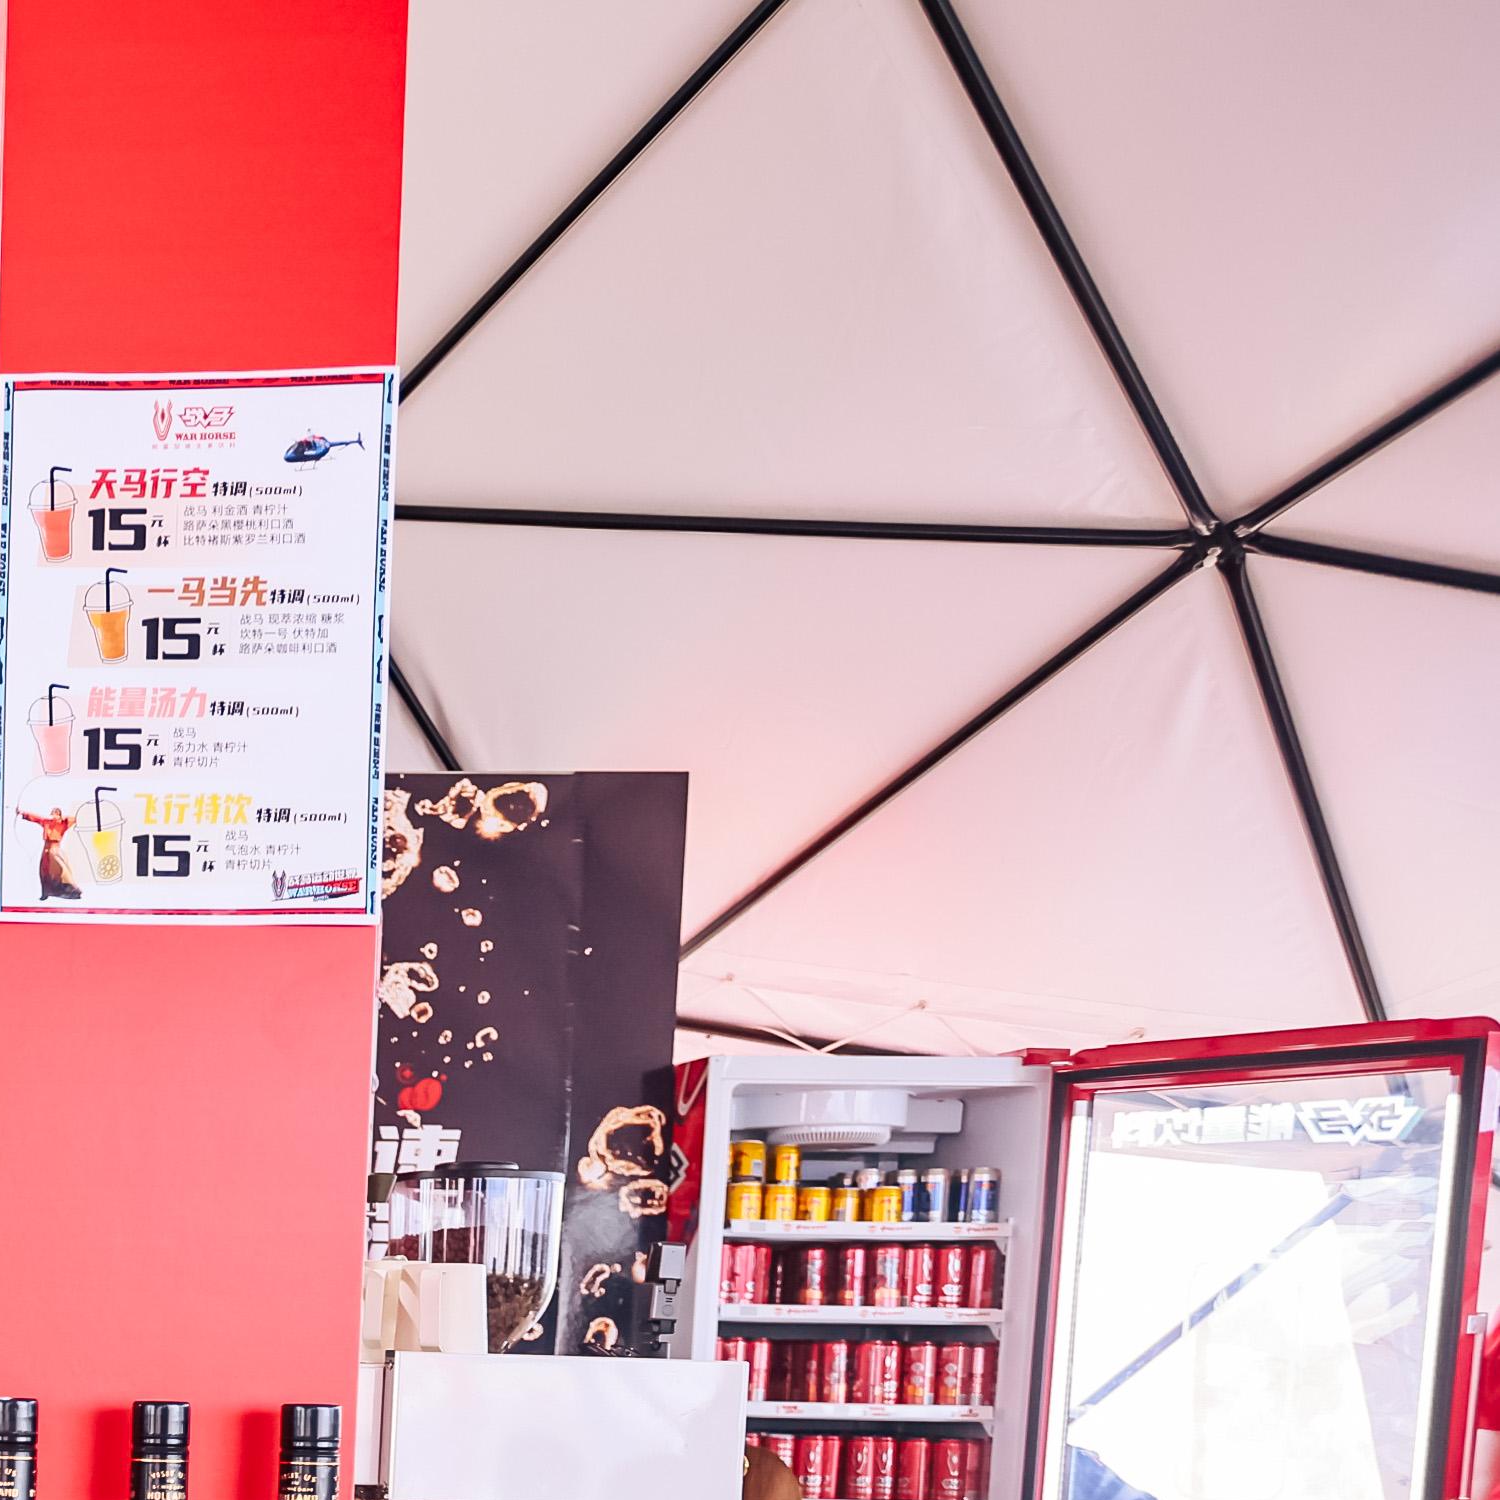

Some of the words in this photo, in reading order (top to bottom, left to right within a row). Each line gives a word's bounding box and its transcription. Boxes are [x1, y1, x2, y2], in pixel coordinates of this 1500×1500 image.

[200, 432, 236, 440] HORSE
[89, 467, 210, 499] 天马行空
[184, 504, 207, 516] 战马
[212, 503, 248, 516] 利金酒
[253, 503, 288, 515] 青柠汁
[88, 508, 147, 551] 15
[148, 576, 268, 607] 一马当先
[240, 613, 263, 625] 战马
[268, 613, 317, 625] 现萃浓缩
[321, 612, 345, 624] 糖浆
[142, 617, 201, 660] 15
[239, 628, 288, 640] 坎特一号
[293, 627, 329, 639] 伏特加
[87, 686, 208, 718] 能量汤力
[173, 727, 197, 739] 战马
[84, 727, 142, 771] 15
[173, 742, 208, 753] 汤力水
[213, 741, 248, 753] 青柠汁
[173, 756, 220, 768] 青柠切片
[134, 793, 252, 825] 飞行特饮
[225, 830, 248, 842] 战马
[132, 834, 191, 877] 15
[225, 844, 260, 856] 气泡水
[265, 844, 300, 856] 青柠汁
[225, 859, 271, 871] 青柠切片
